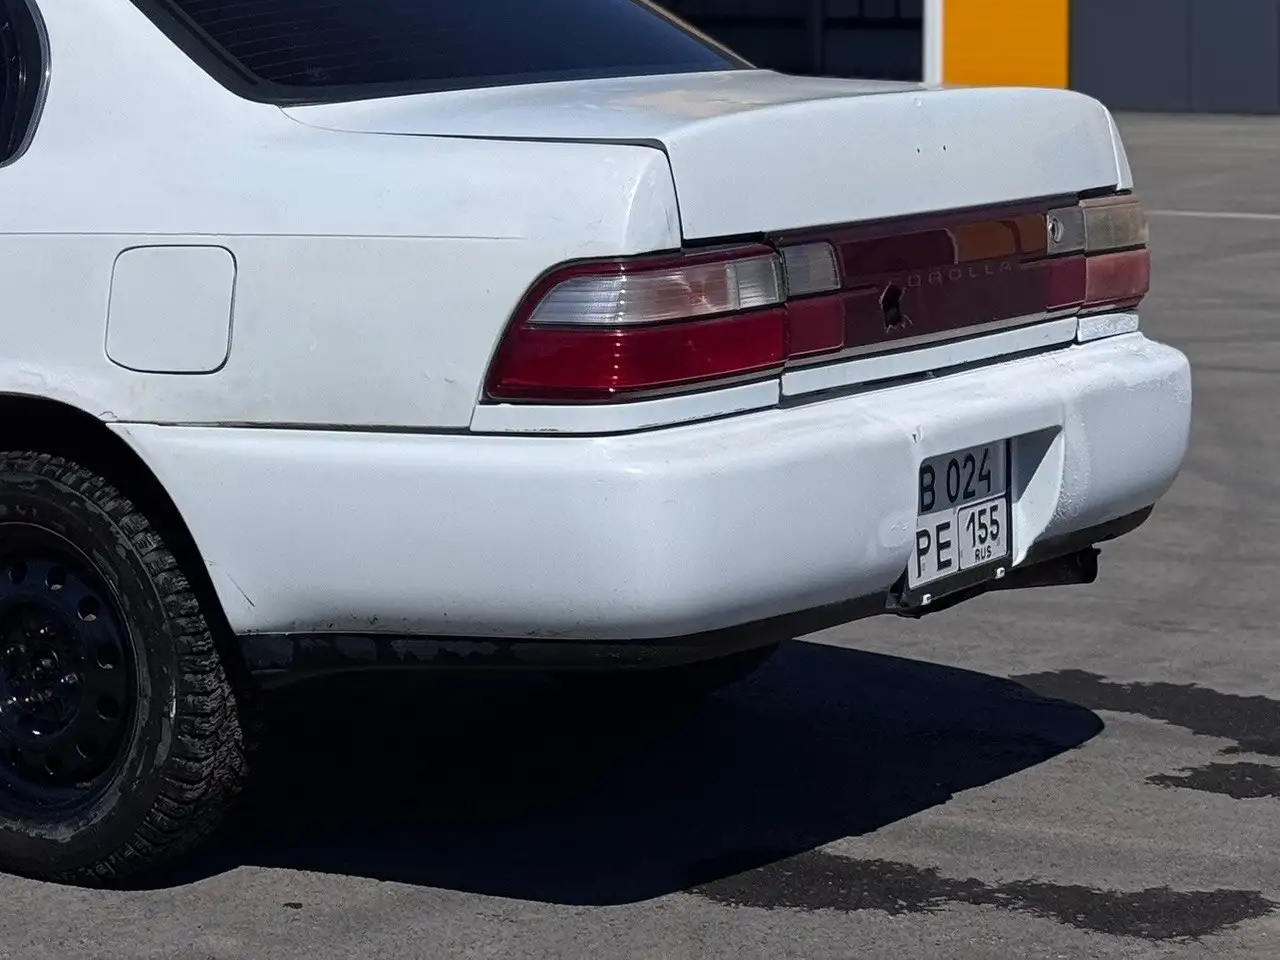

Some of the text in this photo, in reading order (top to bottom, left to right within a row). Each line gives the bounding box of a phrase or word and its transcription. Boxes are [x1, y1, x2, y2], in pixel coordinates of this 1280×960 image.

[889, 260, 1013, 288] OROLLA
[946, 447, 992, 504] 024
[966, 504, 1000, 549] 155
[974, 544, 993, 562] RUS
